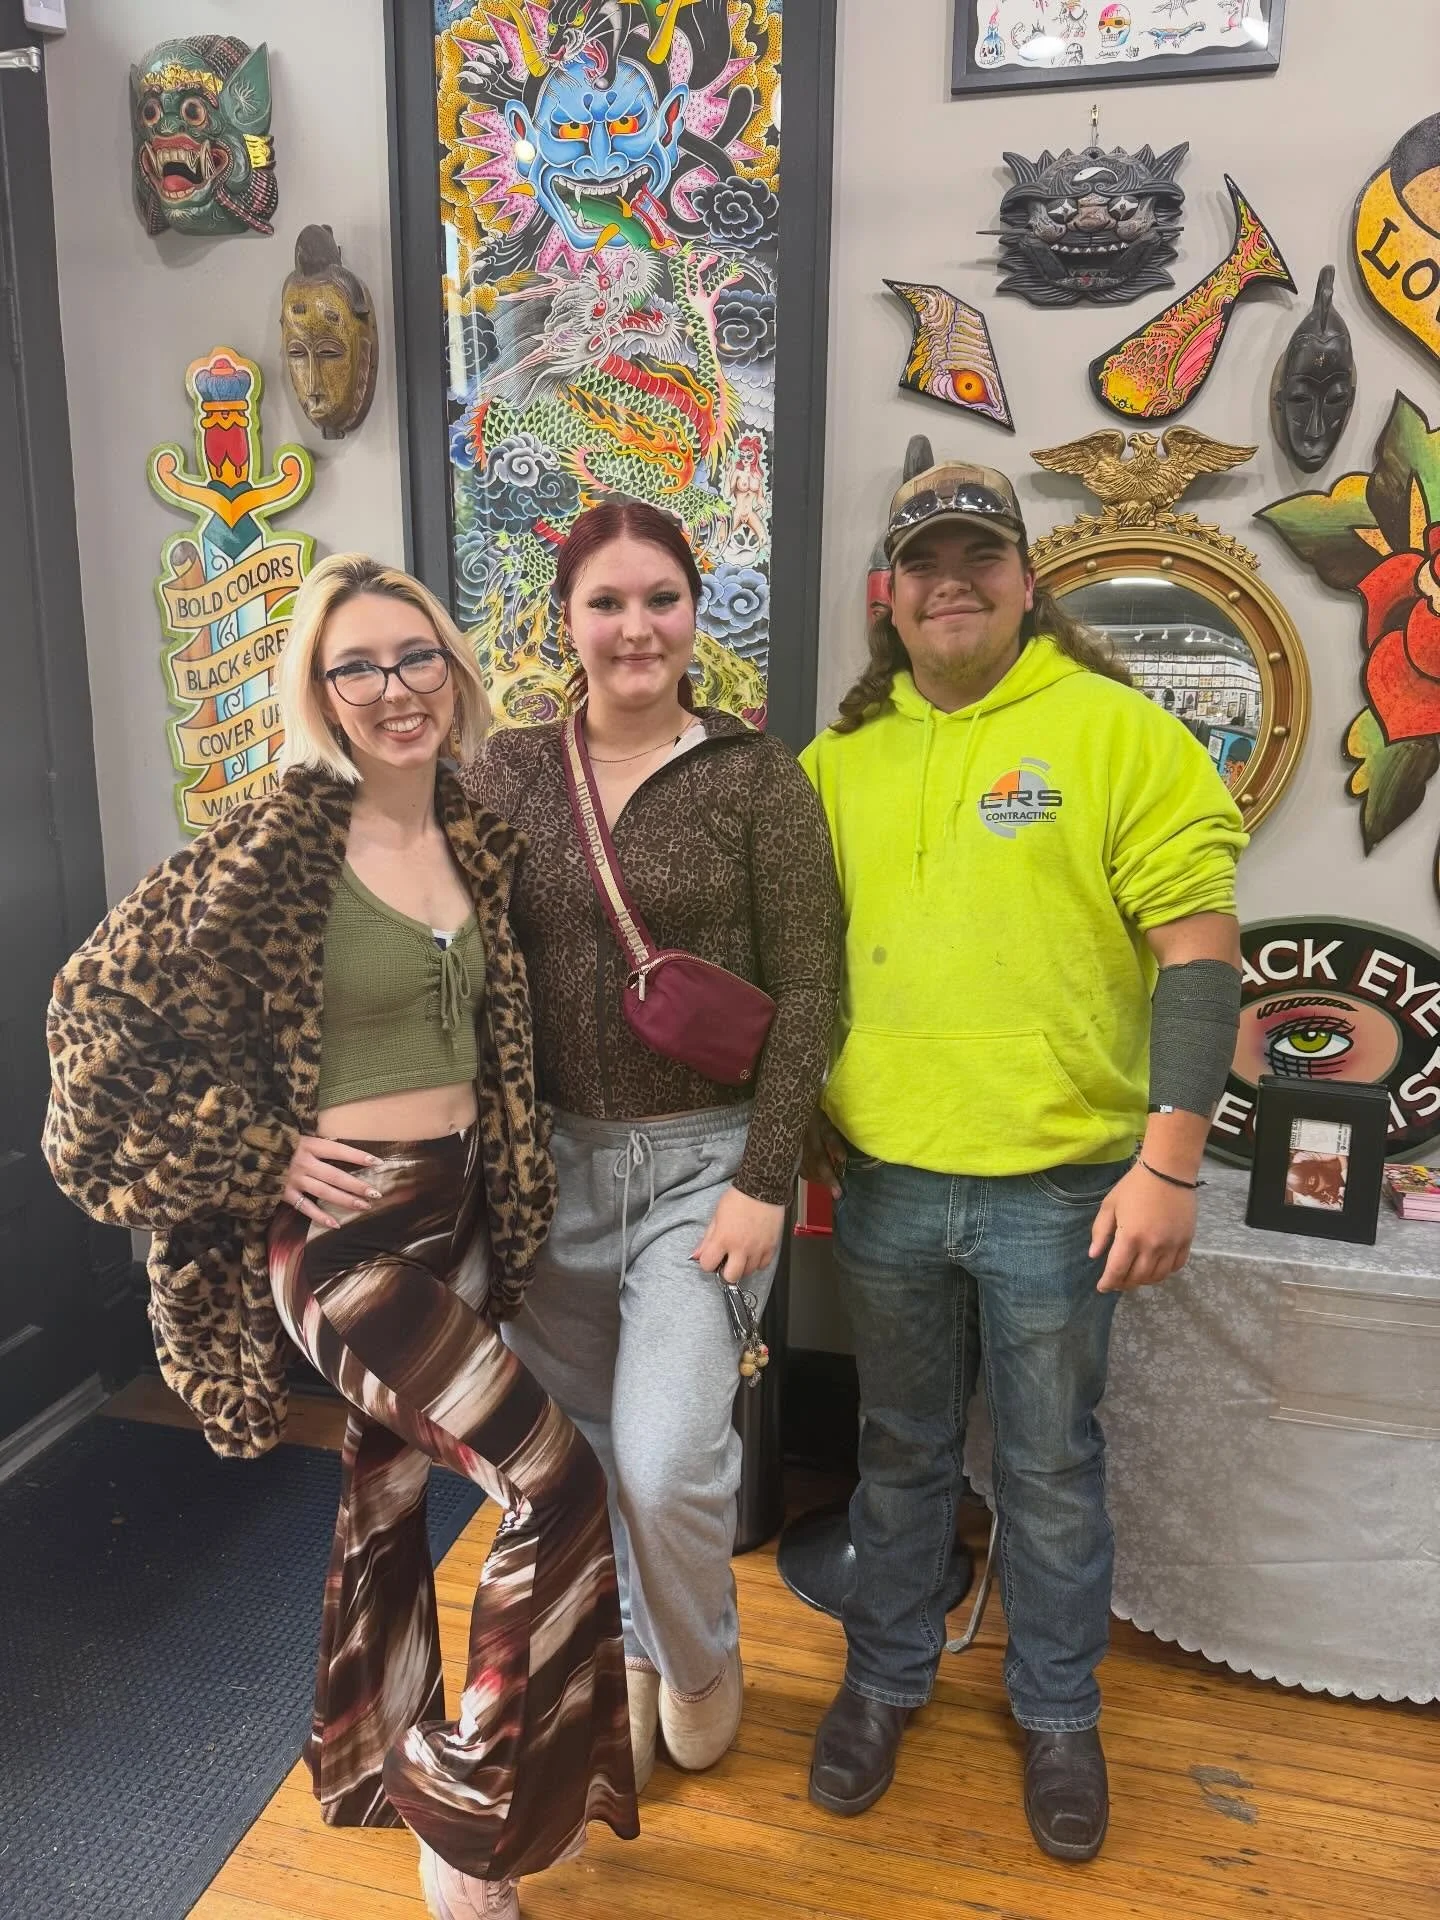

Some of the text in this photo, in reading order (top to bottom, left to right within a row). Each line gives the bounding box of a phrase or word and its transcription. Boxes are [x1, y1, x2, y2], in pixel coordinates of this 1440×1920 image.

[1362, 216, 1440, 324] LO
[177, 556, 294, 619] BOLD COLORS
[187, 653, 241, 692] BLACK
[243, 649, 252, 668] &
[199, 718, 256, 757] COVER
[980, 789, 1063, 810] ERS
[985, 811, 1057, 821] CONTRACTING
